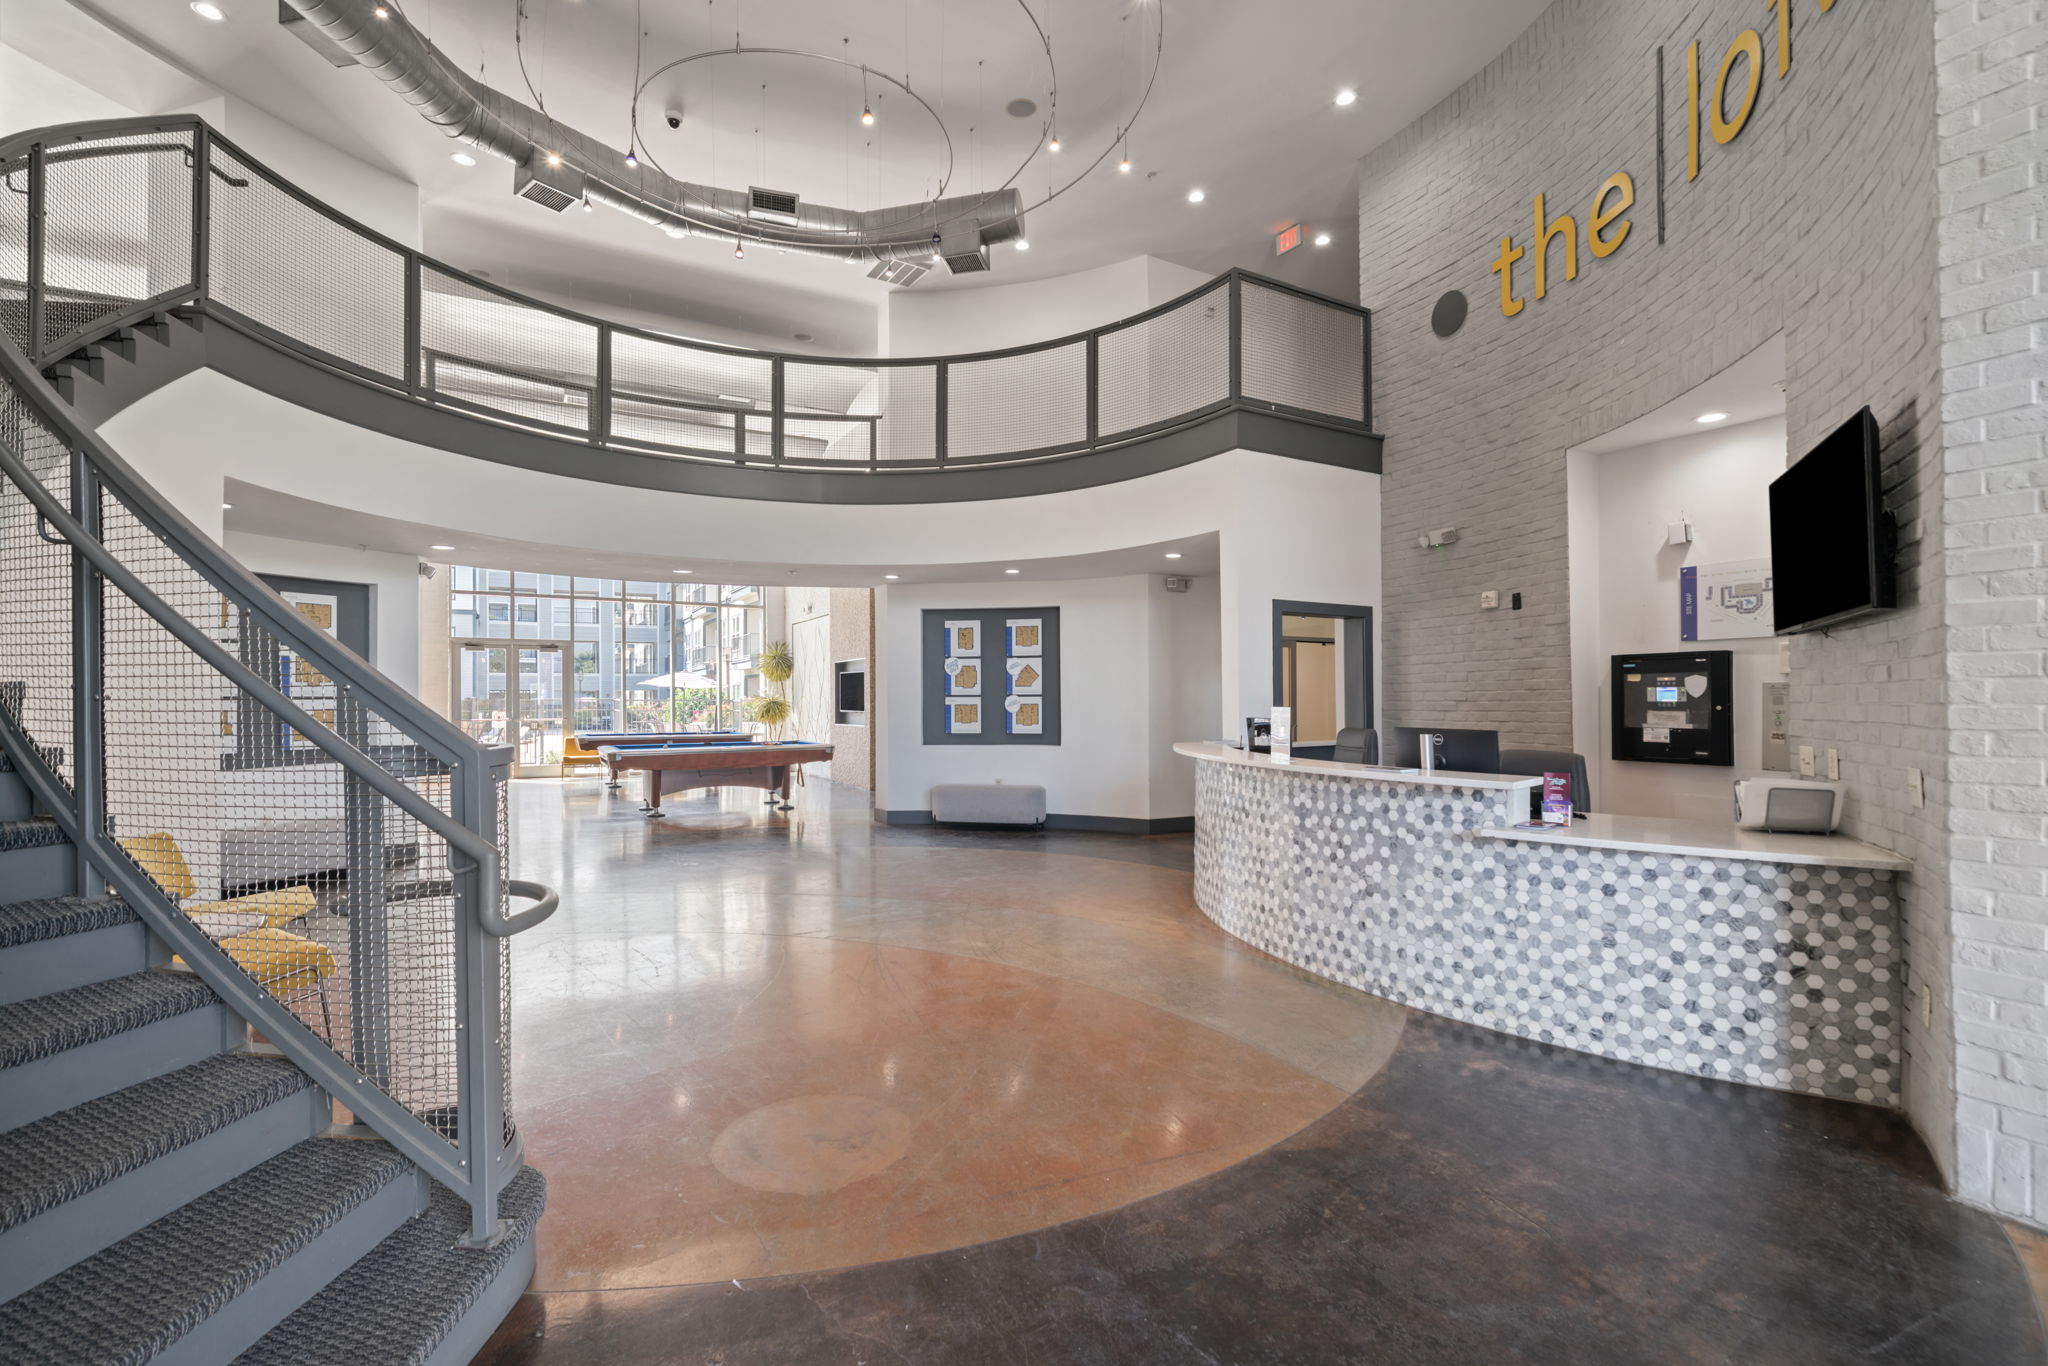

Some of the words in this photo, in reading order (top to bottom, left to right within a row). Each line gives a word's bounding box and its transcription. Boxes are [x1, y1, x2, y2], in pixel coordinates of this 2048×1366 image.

[1488, 171, 1635, 317] the
[1687, 0, 1837, 183] lo
[1279, 226, 1297, 252] EXIT
[1685, 592, 1693, 605] MAP
